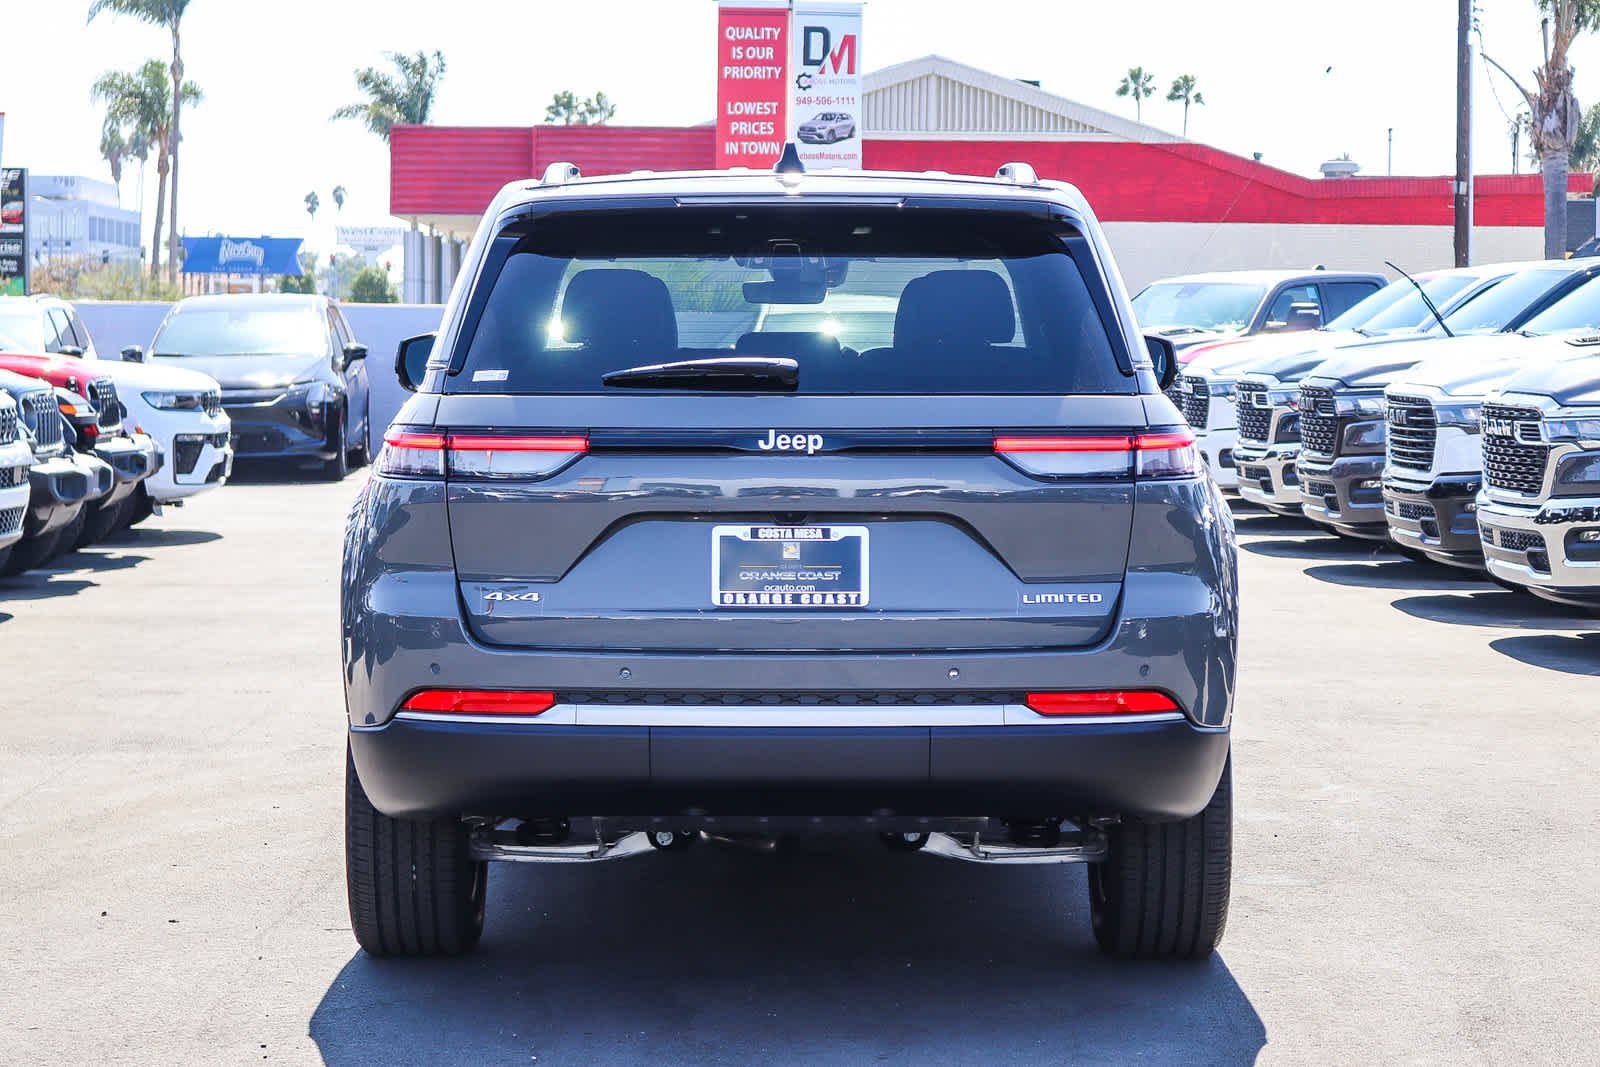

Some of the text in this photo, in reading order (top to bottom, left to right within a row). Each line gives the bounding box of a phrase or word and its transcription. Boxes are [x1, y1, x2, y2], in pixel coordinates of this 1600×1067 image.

[725, 26, 781, 41] QUALITY
[732, 46, 774, 60] IS OUR
[723, 66, 782, 80] PRIORITY
[727, 102, 778, 115] LOWEST
[730, 121, 775, 135] PRICES
[725, 141, 780, 155] IN TOWN
[758, 429, 824, 454] Jeep
[758, 528, 793, 539] COSTA
[739, 571, 842, 581] ORANGE COAST
[763, 583, 816, 592] ocauto.com
[483, 591, 539, 601] 4x4
[723, 593, 860, 605] ORANGE COAST
[1023, 593, 1103, 604] LIMITED
